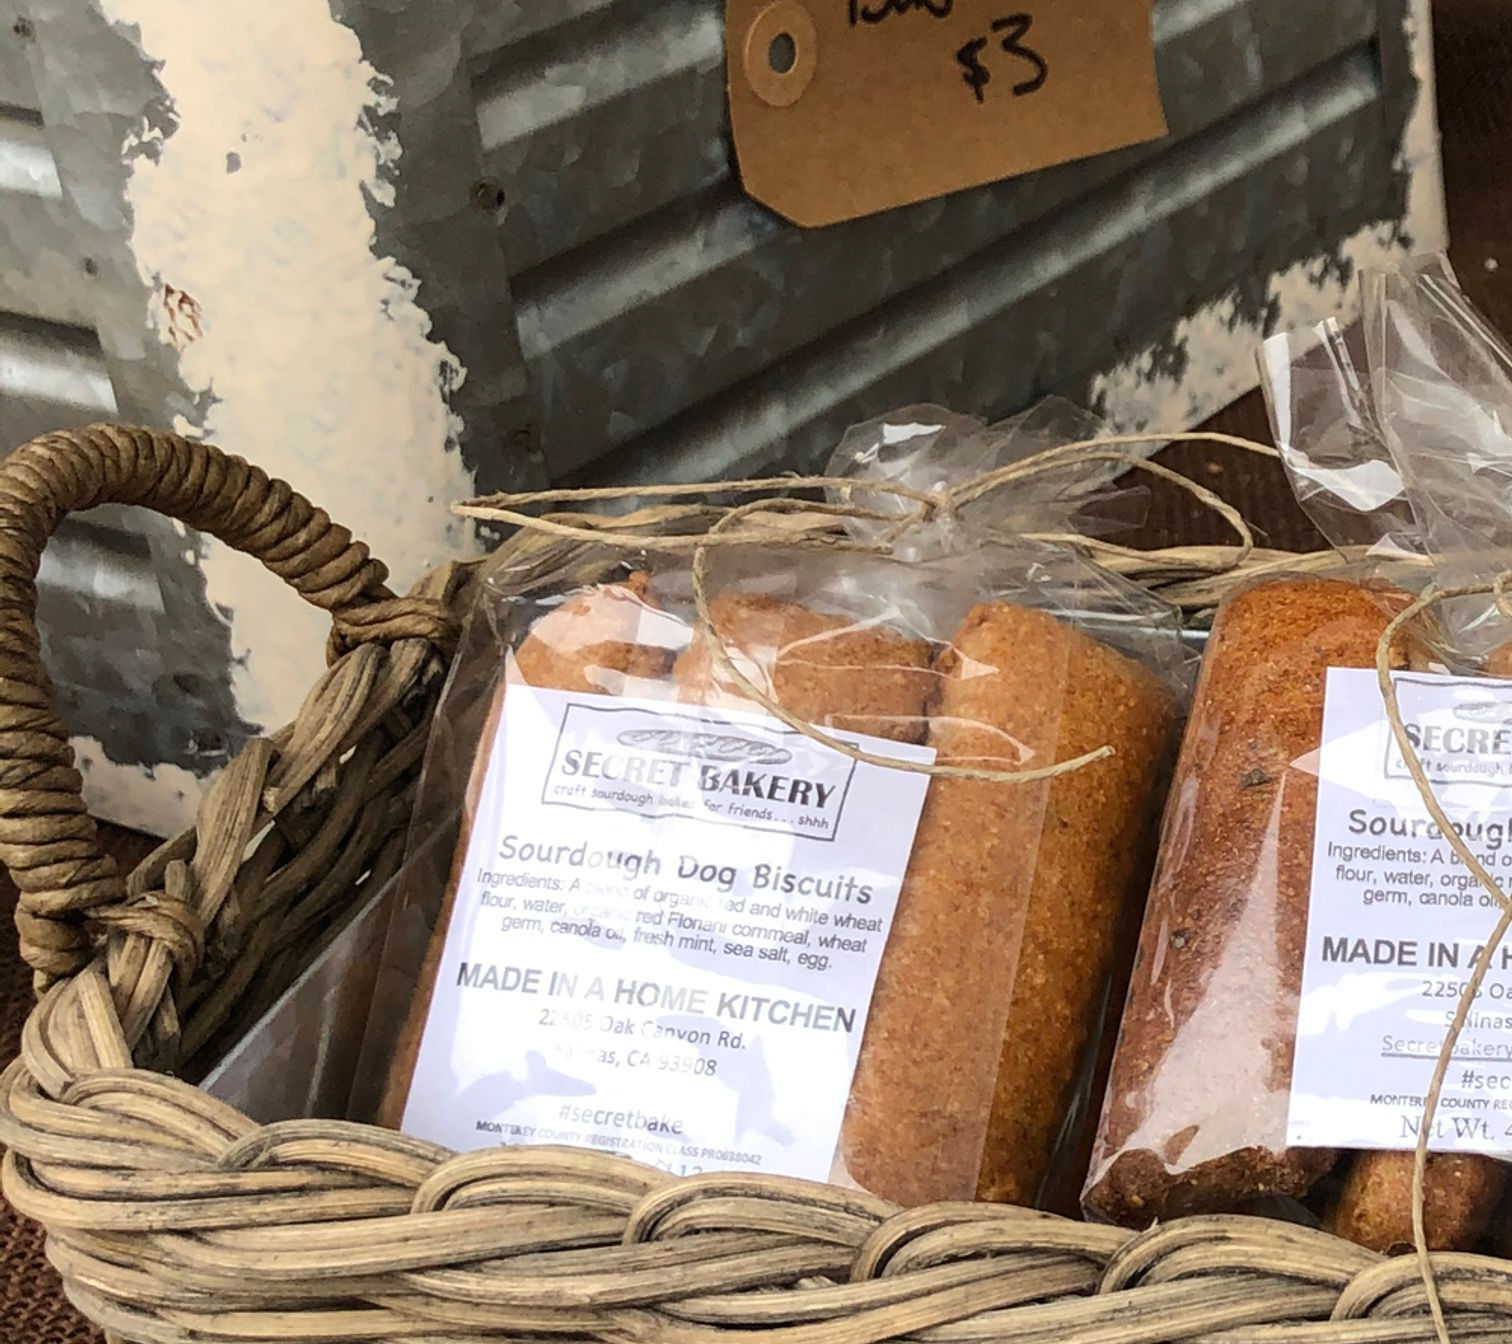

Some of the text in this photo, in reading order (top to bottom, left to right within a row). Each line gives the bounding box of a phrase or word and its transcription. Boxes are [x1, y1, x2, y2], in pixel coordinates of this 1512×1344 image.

[956, 13, 1049, 104] $3
[561, 748, 836, 809] SECRET BAKERY
[498, 834, 662, 881] Sourdough
[677, 855, 737, 893] Dog
[752, 863, 873, 905] Biscuits
[1327, 840, 1427, 864] Ingredients:
[1429, 847, 1445, 865] A
[1335, 863, 1377, 886] flour,
[1383, 869, 1434, 889] water,
[567, 877, 581, 893] A
[632, 884, 652, 901] of
[748, 902, 783, 919] and
[785, 905, 830, 926] white
[833, 912, 884, 933] wheat
[1362, 888, 1412, 907] germ,
[1418, 890, 1474, 907] canola
[522, 898, 568, 918] water,
[635, 909, 665, 926] red
[731, 923, 812, 949] cornmeal,
[817, 933, 868, 953] wheat
[500, 915, 544, 934] germ,
[550, 914, 602, 938] canola
[633, 926, 675, 948] fresh
[677, 933, 717, 955] mint,
[723, 942, 755, 958] sea
[757, 945, 791, 966] salt,
[797, 952, 833, 972] egg.
[1321, 935, 1418, 967] MADE
[1427, 941, 1460, 969] IN
[455, 961, 857, 1034] MADE IN A HOME KITCHEN
[717, 1030, 746, 1050] Rd.
[559, 1105, 683, 1136] #secretbake
[1440, 1097, 1491, 1110] COUNTY
[1451, 1116, 1495, 1141] Wt.
